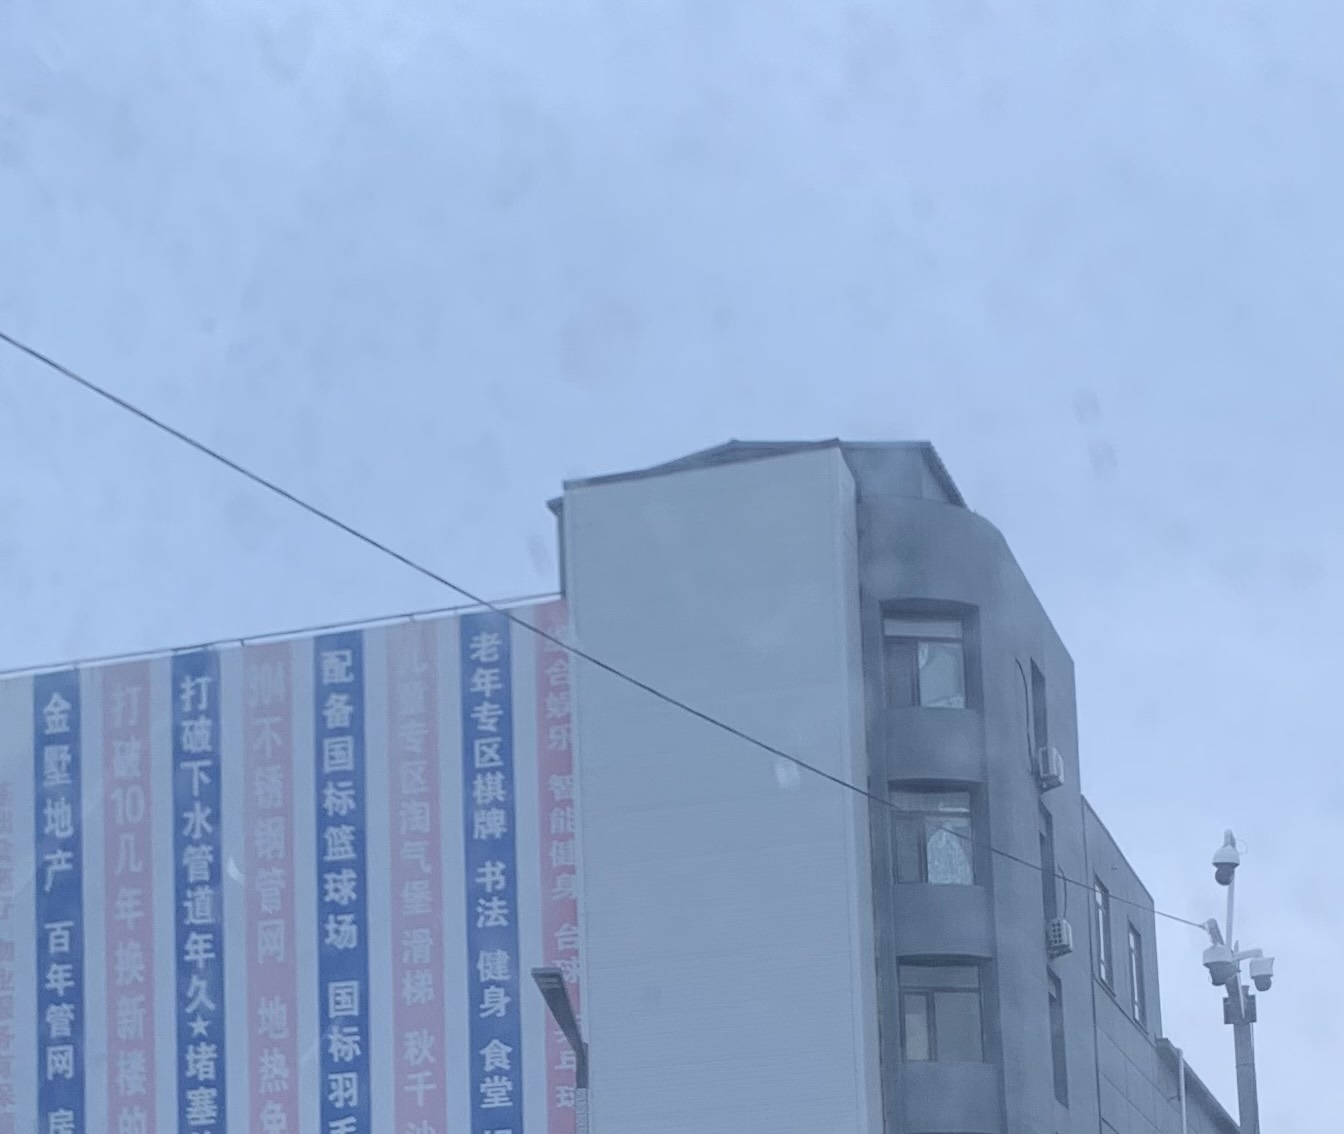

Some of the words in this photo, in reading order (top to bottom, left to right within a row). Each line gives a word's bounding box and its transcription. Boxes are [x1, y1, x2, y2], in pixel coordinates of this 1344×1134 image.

[43, 692, 74, 892] 金墅地产
[469, 630, 507, 840] 老年专区棋牌
[320, 648, 360, 950] 配备国标篮球场
[476, 860, 509, 929] 书法
[44, 920, 76, 1081] 百年管网
[476, 948, 511, 1019] 健身
[403, 1029, 437, 1109] 秋千
[479, 1038, 513, 1110] 食堂
